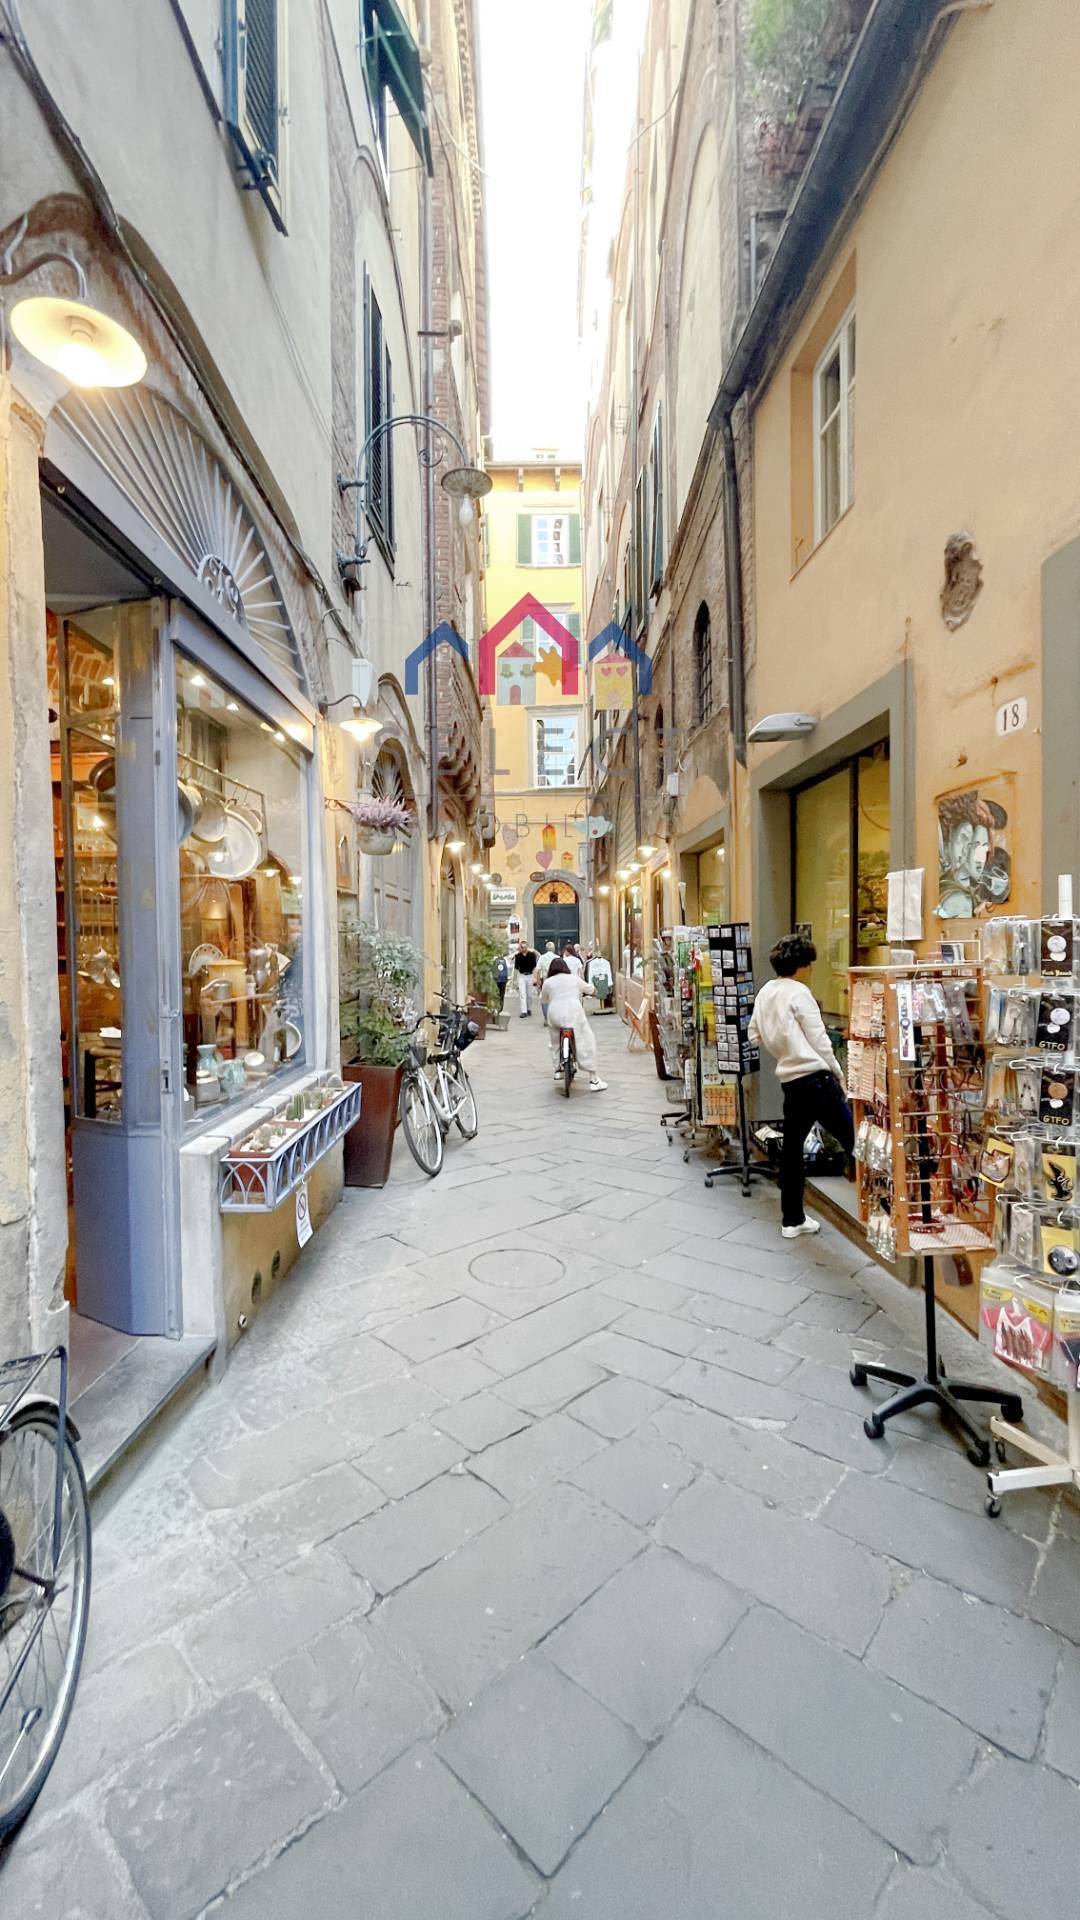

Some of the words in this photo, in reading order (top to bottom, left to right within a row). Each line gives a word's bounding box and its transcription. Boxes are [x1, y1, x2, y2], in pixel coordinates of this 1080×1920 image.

[1002, 703, 1020, 732] 18
[1039, 1040, 1066, 1051] GTFO
[1043, 1114, 1070, 1125] GTFO
